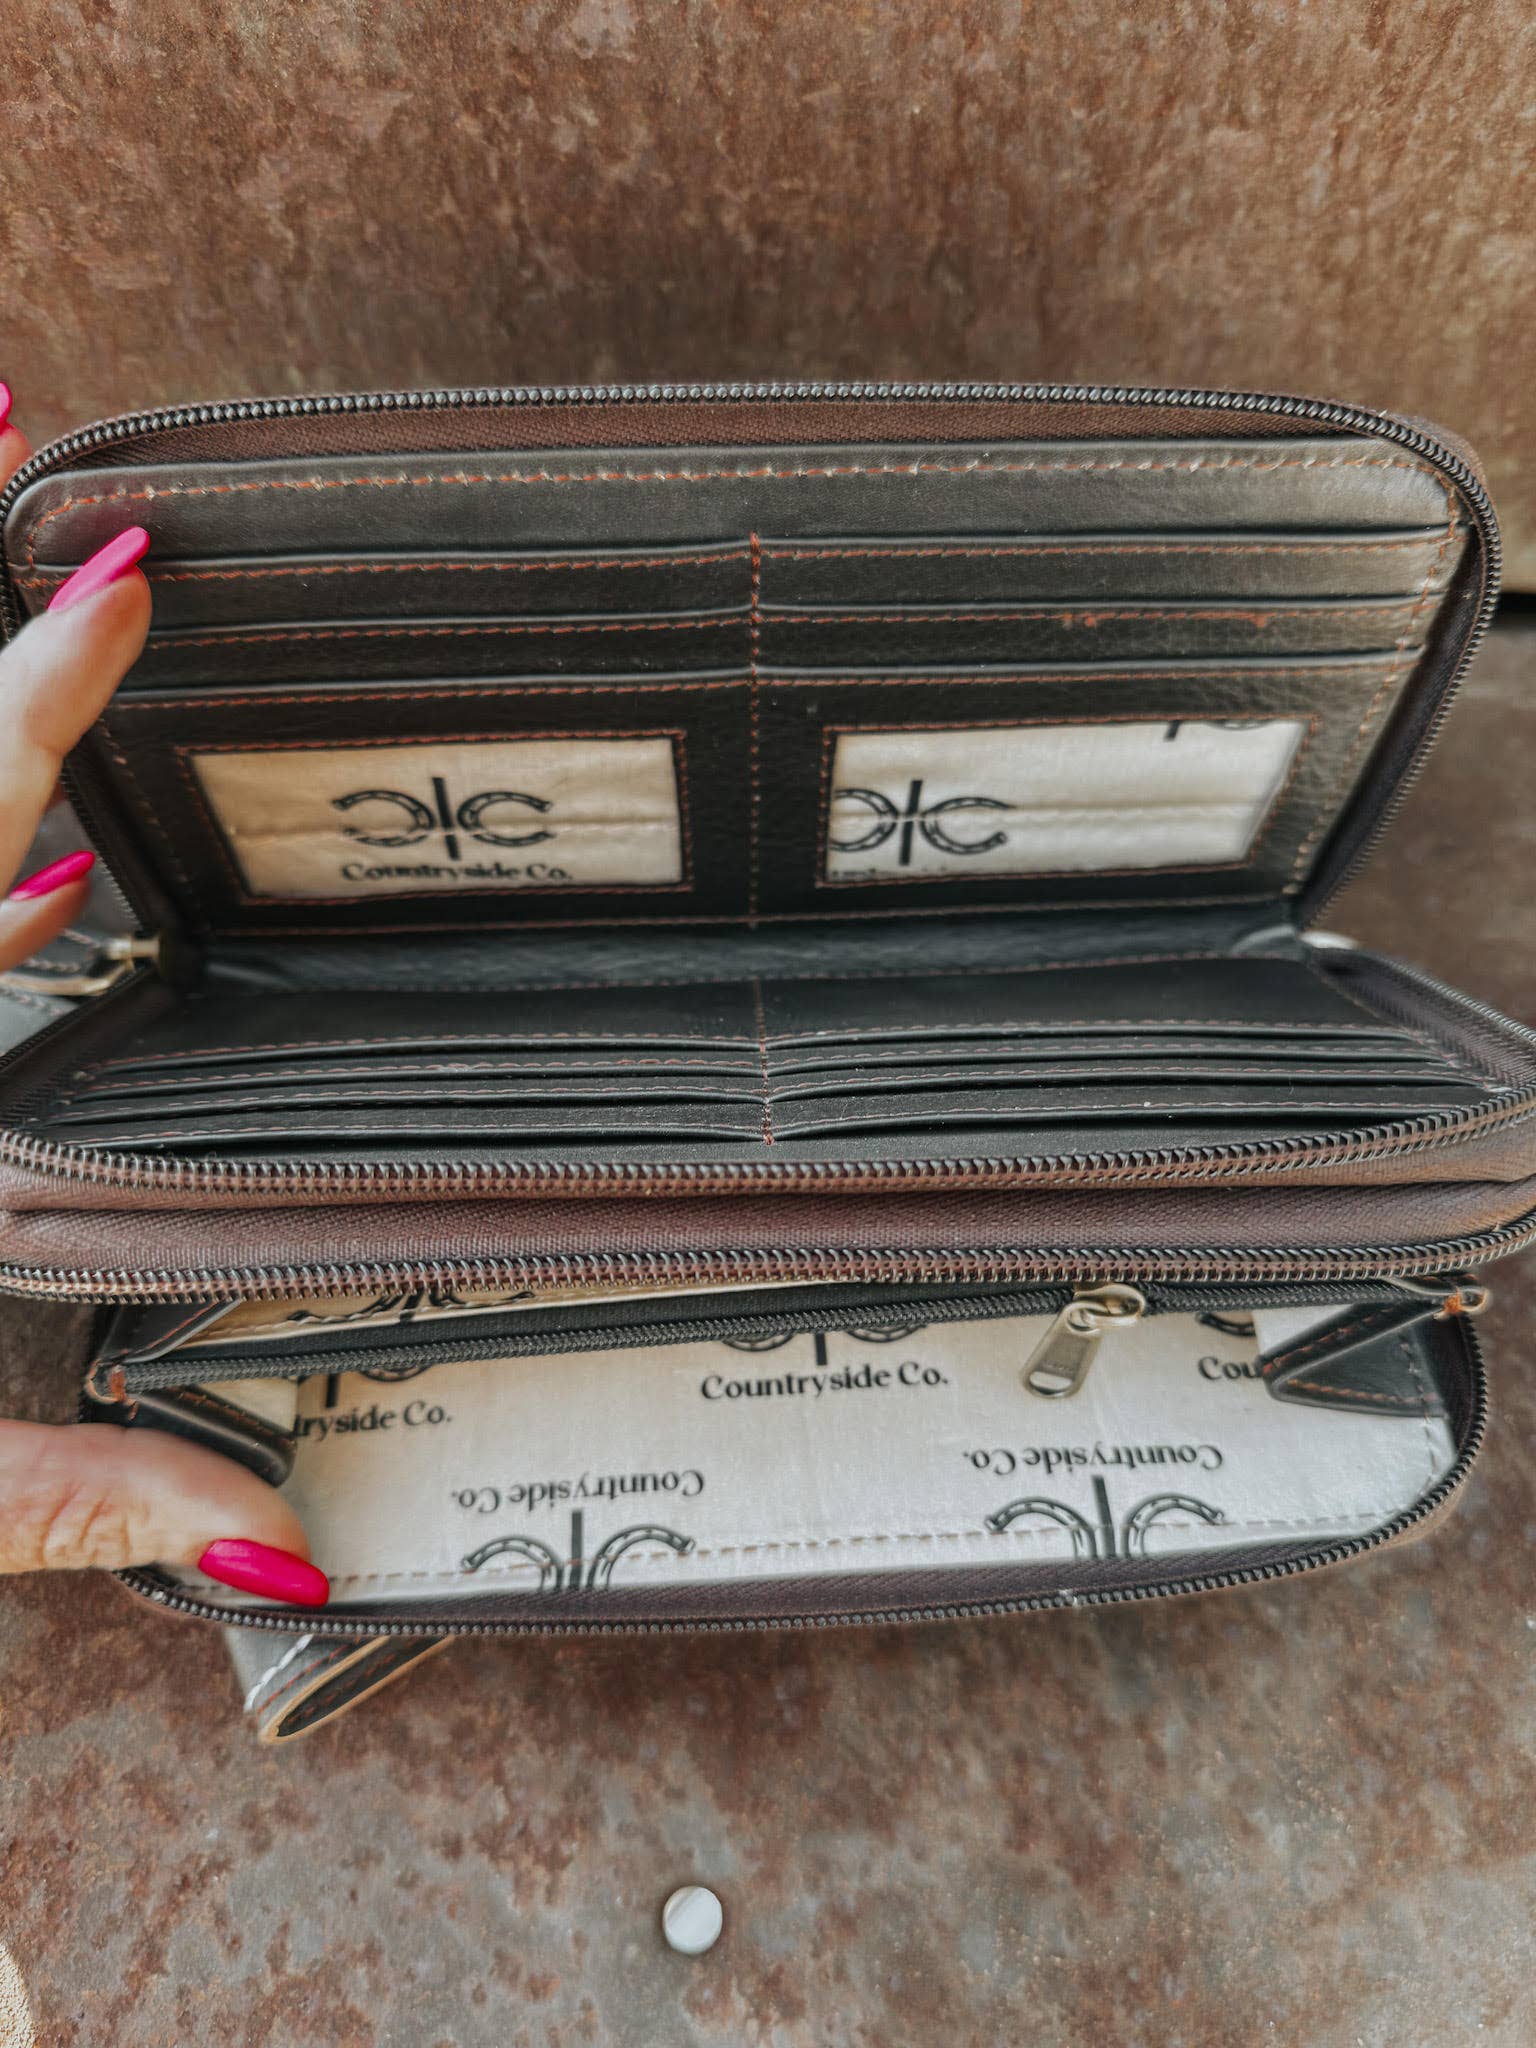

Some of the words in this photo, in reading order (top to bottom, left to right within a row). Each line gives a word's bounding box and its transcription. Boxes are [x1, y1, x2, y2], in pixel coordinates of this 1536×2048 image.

[341, 863, 520, 882] Countryside
[525, 863, 572, 880] Co.
[701, 1364, 891, 1399] Countryside
[898, 1361, 948, 1386] Co.
[403, 1400, 452, 1426] Co.
[964, 1449, 1016, 1475] Co.
[1024, 1441, 1223, 1474] Countryside
[452, 1487, 500, 1513] Co.
[508, 1470, 704, 1511] Countryside
